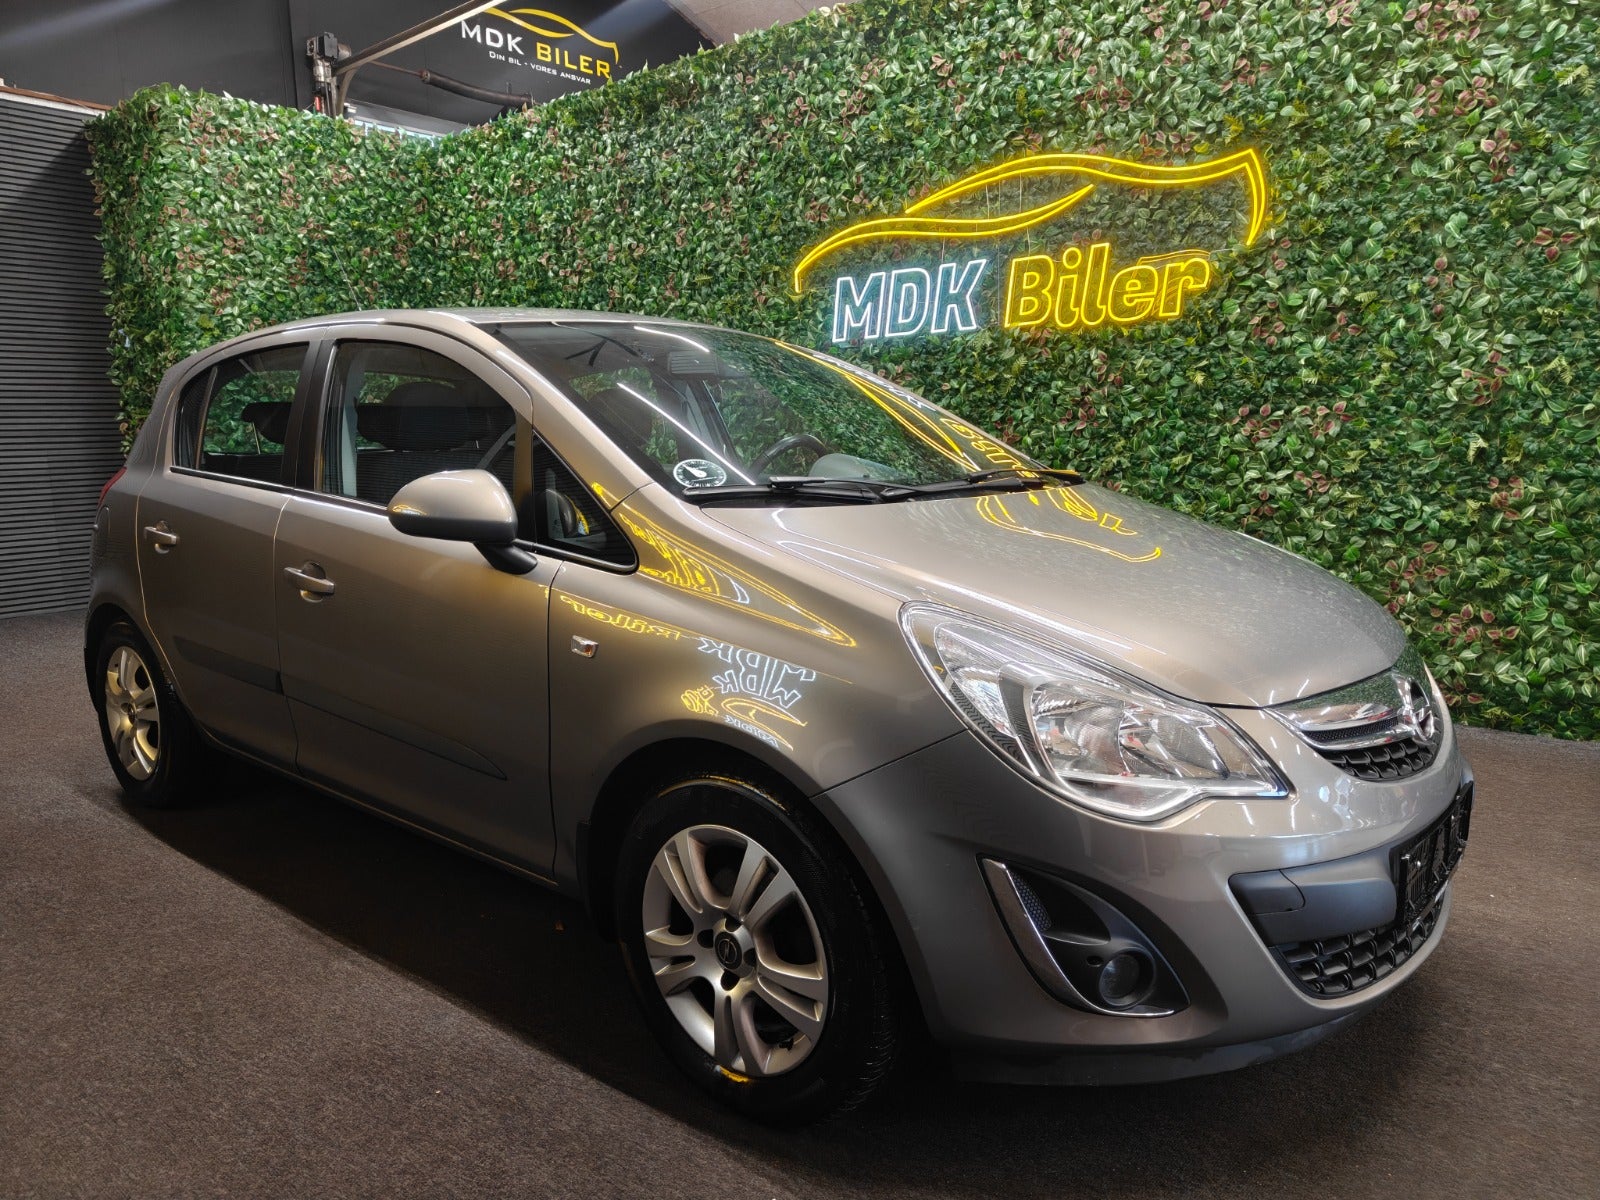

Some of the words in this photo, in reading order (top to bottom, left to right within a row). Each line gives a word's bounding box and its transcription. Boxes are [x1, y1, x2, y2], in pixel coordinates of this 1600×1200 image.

[461, 20, 525, 55] MDK
[536, 42, 611, 79] BILER
[530, 62, 558, 76] VORES
[560, 71, 592, 85] ANSVAR
[832, 258, 987, 343] MDK
[1004, 242, 1211, 328] Biler
